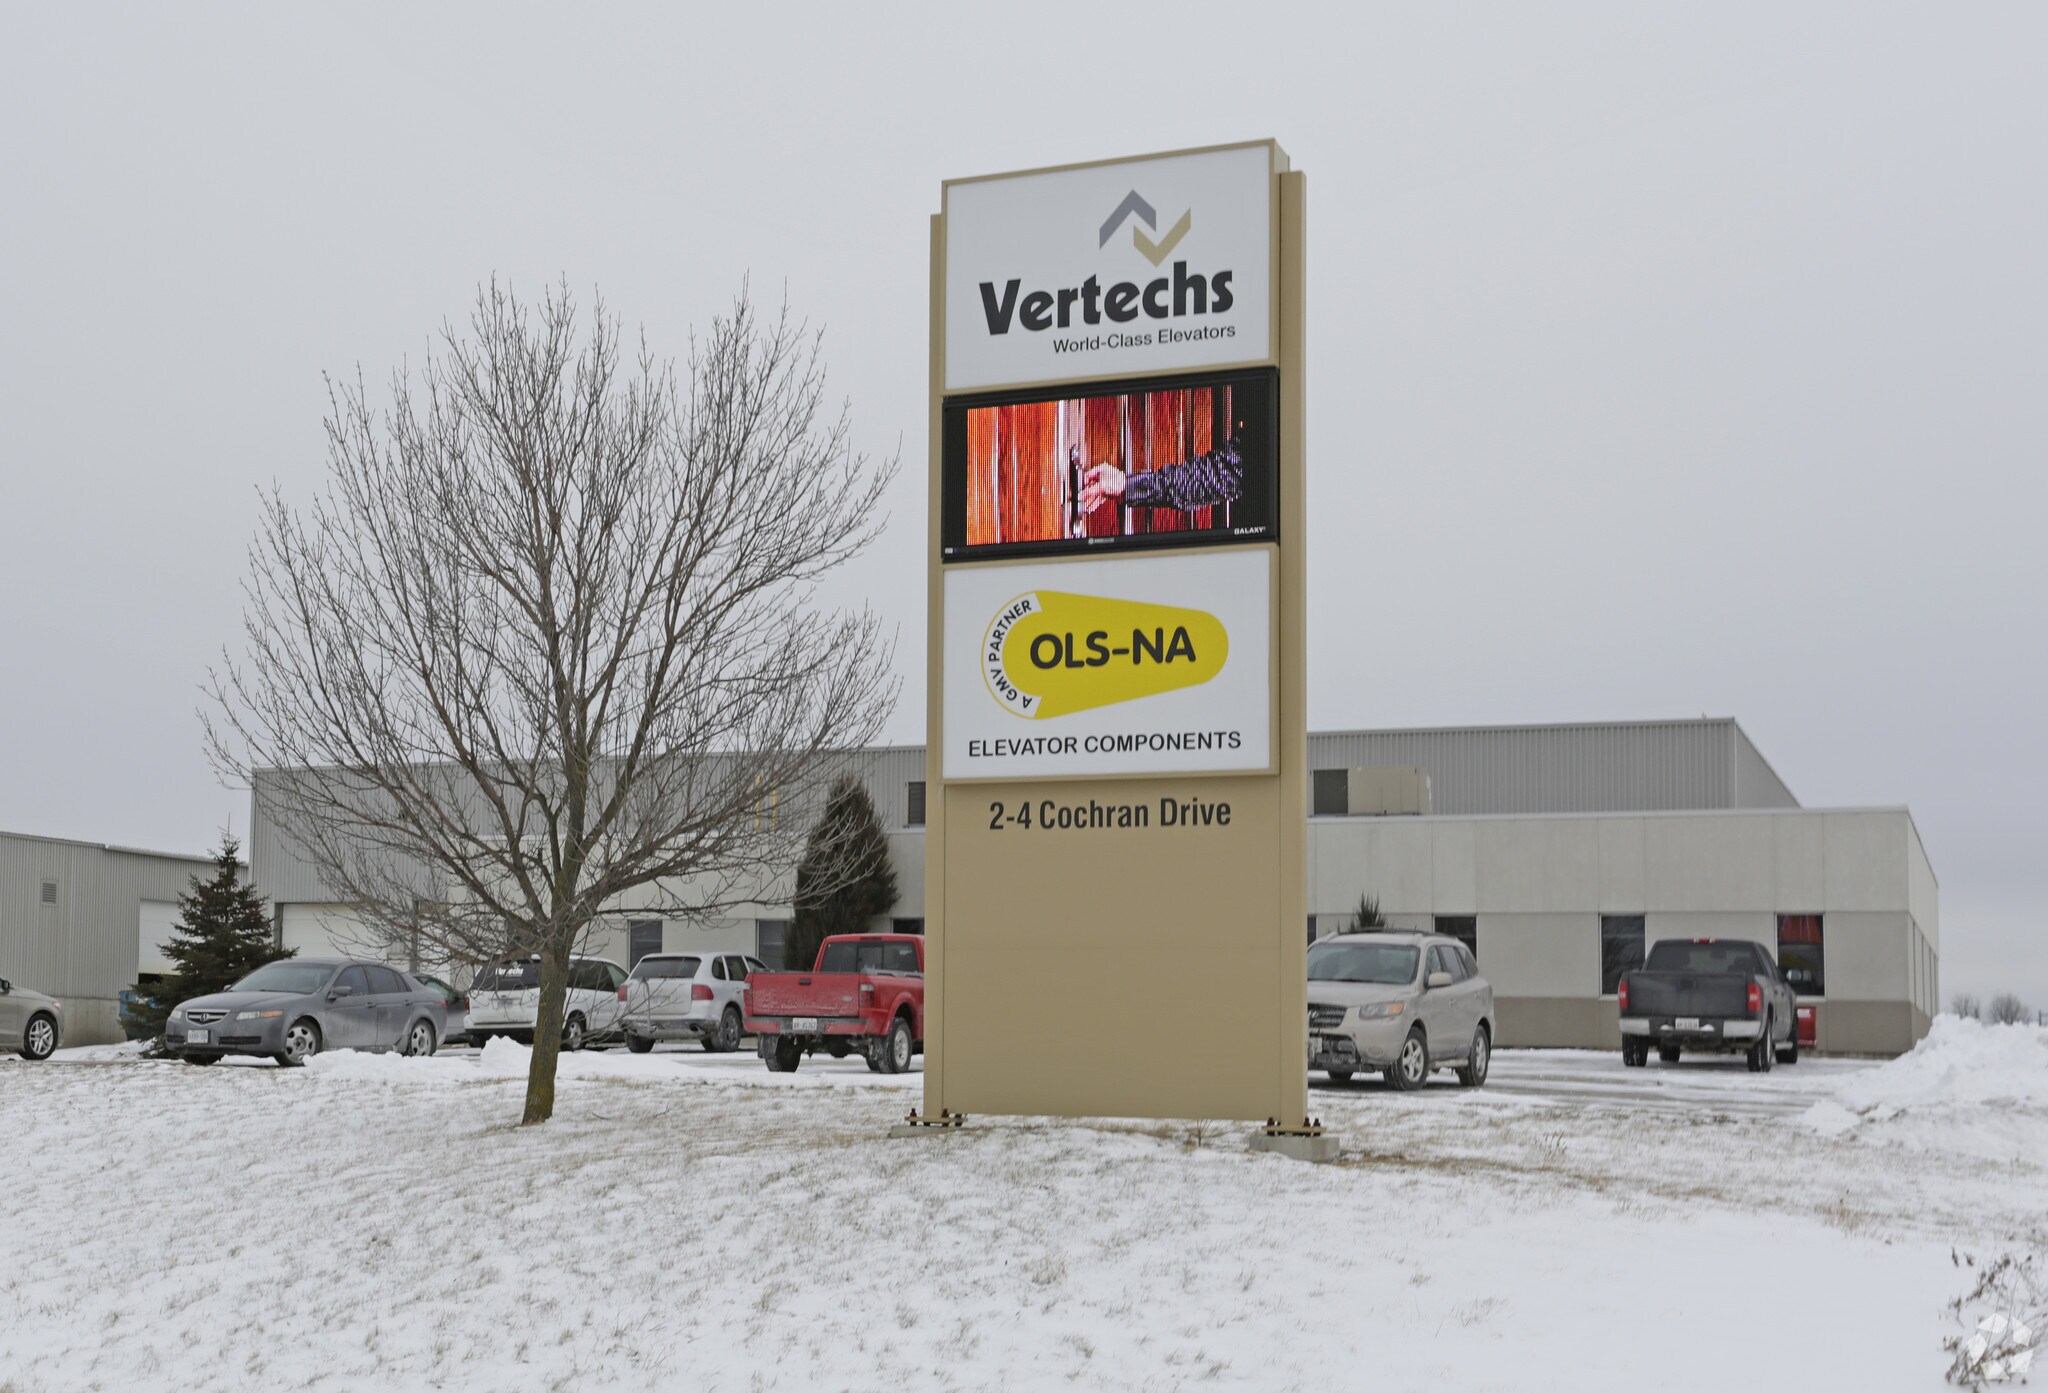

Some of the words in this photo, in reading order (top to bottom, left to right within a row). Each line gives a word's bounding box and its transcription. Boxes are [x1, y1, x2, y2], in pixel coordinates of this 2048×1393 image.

[978, 260, 1234, 336] Vertechs
[1053, 333, 1153, 354] World-Class
[1158, 325, 1236, 344] Elevators
[1234, 526, 1264, 536] GALAXY
[988, 599, 1033, 662] PARTNER
[1029, 625, 1197, 670] OLS-NA
[989, 669, 1018, 701] GMV
[1022, 695, 1034, 709] A
[968, 737, 1078, 758] ELEVATOR
[1084, 730, 1242, 754] COMPONENTS
[989, 801, 1032, 830] 2-4
[1039, 799, 1149, 830] Cochran
[1160, 797, 1232, 827] Drive
